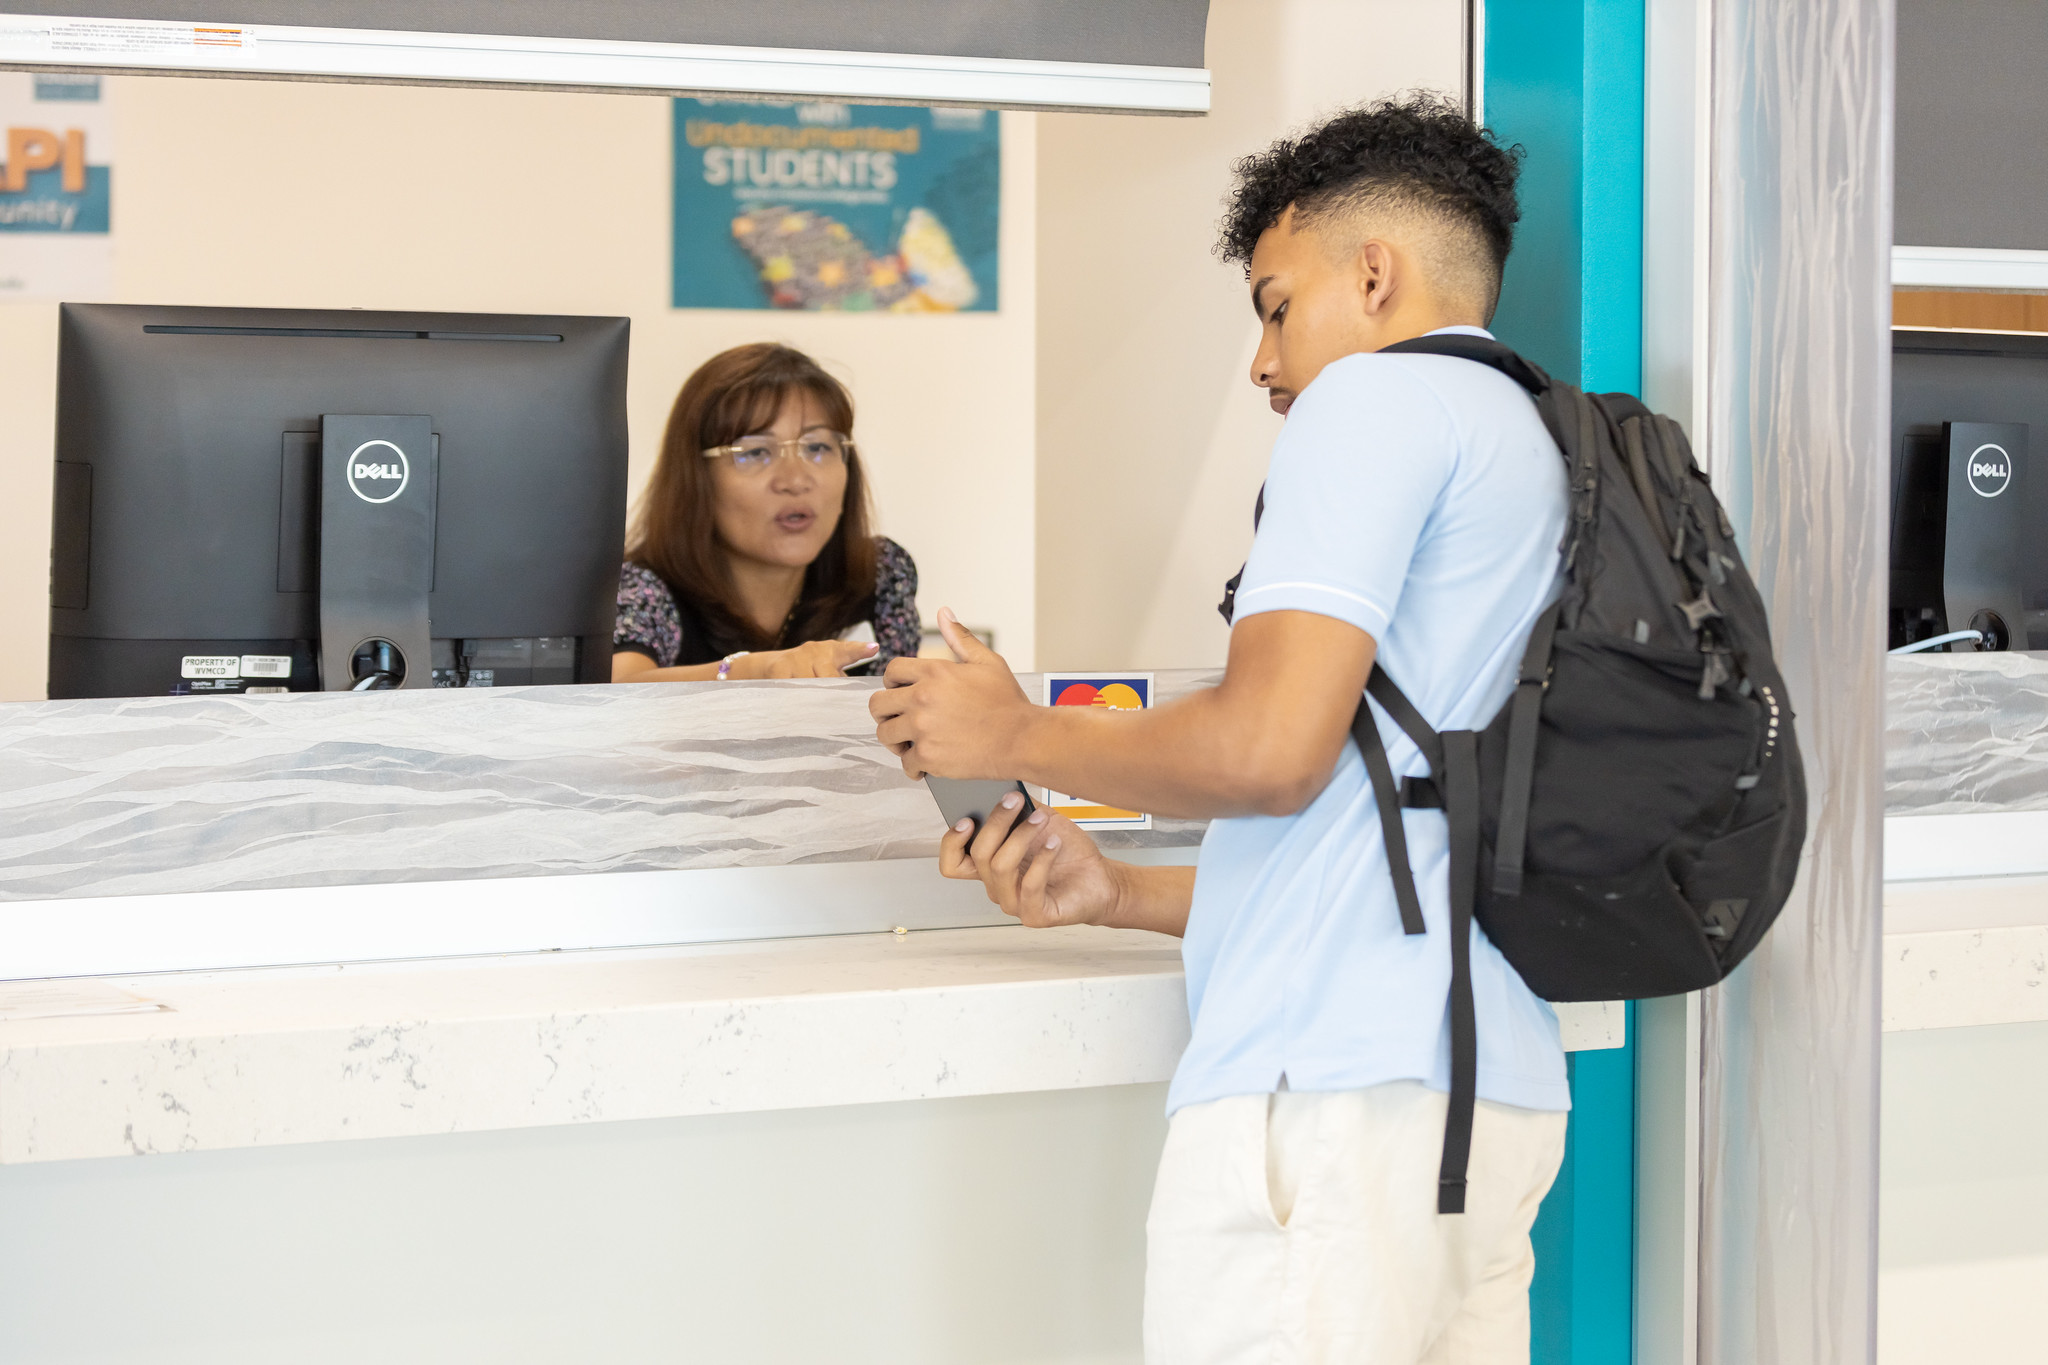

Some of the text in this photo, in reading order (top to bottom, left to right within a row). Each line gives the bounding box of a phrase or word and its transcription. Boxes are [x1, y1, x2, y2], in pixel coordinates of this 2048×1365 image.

[685, 118, 920, 154] Undocumented
[0, 127, 86, 192] PI
[702, 146, 898, 190] STUDENTS
[354, 463, 402, 480] DELL
[1973, 462, 2007, 478] DELL
[184, 658, 224, 666] PROPERTY
[226, 658, 237, 666] OF
[194, 667, 226, 675] WVMCCD
